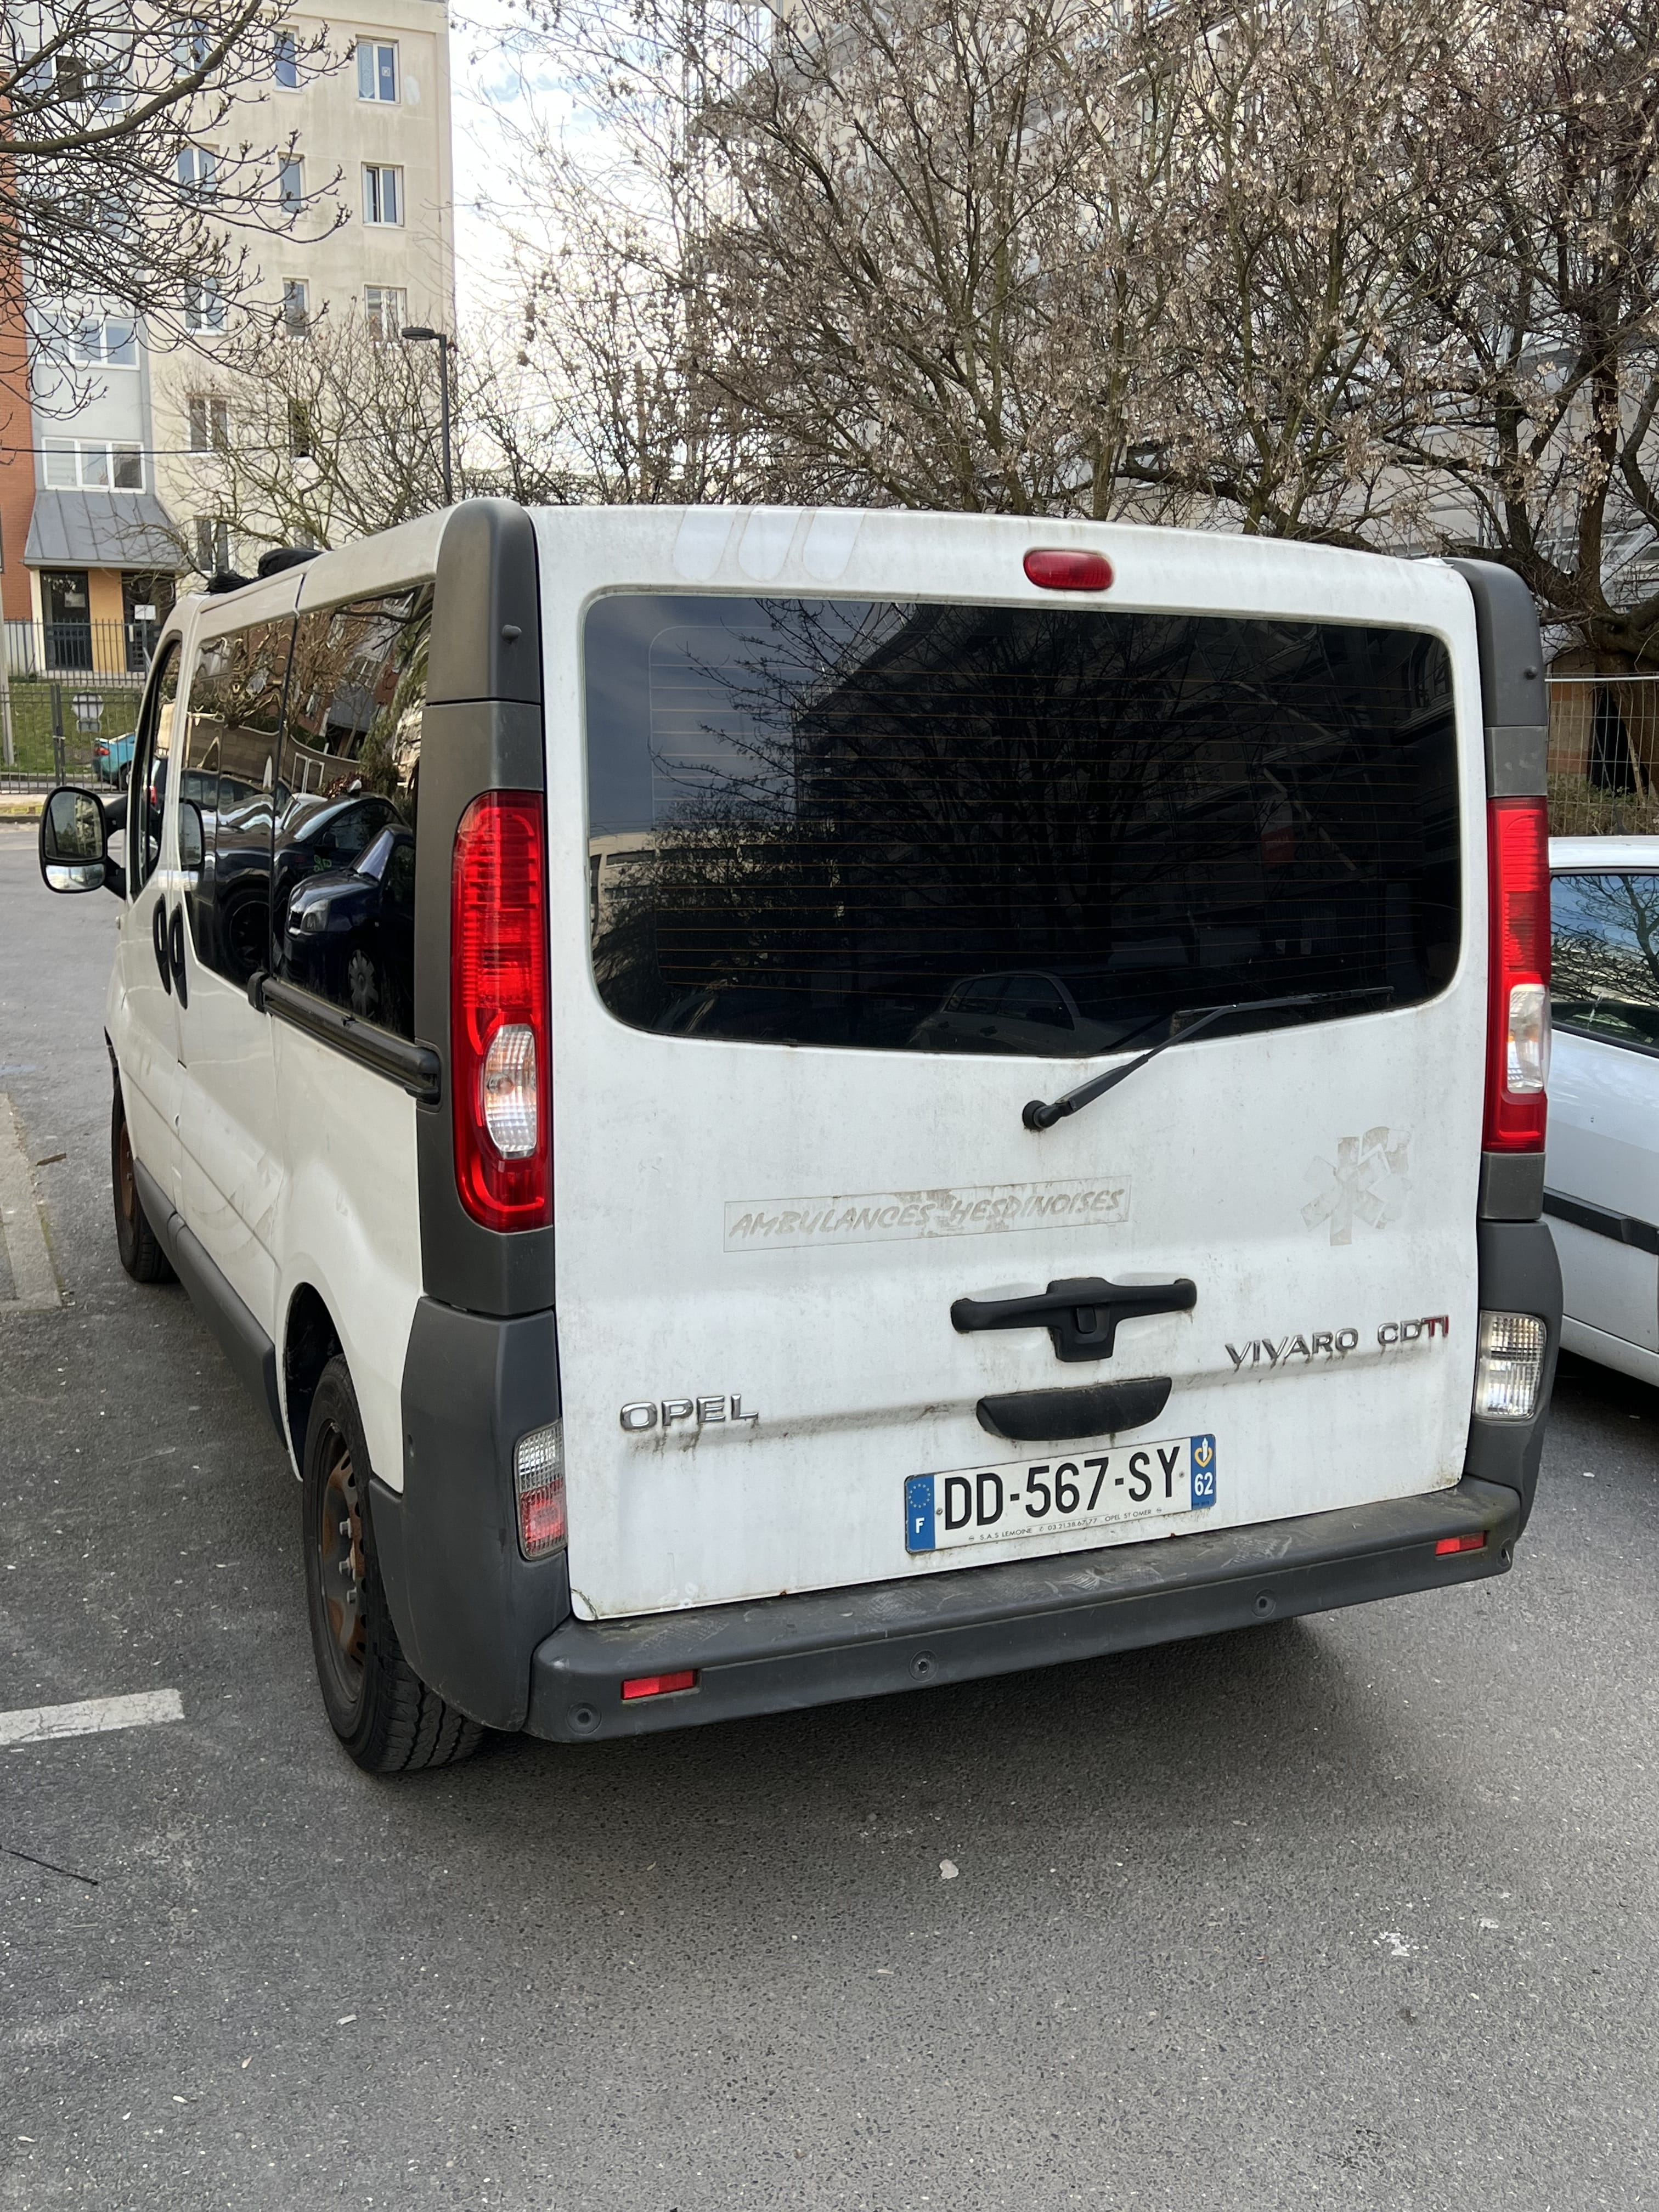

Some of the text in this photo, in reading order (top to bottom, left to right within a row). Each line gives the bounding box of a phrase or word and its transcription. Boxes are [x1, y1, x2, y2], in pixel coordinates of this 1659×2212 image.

[729, 1188, 1125, 1238] AMBULANCES HESDINOISES
[1224, 1314, 1449, 1365] VIVARO CDTI
[620, 1393, 759, 1431] OPEL
[944, 1446, 1180, 1531] DD-567-SY
[1194, 1471, 1214, 1496] 62
[915, 1517, 925, 1534] F
[1002, 1527, 1032, 1537] LEMOINE
[1132, 1509, 1152, 1518] OMER
